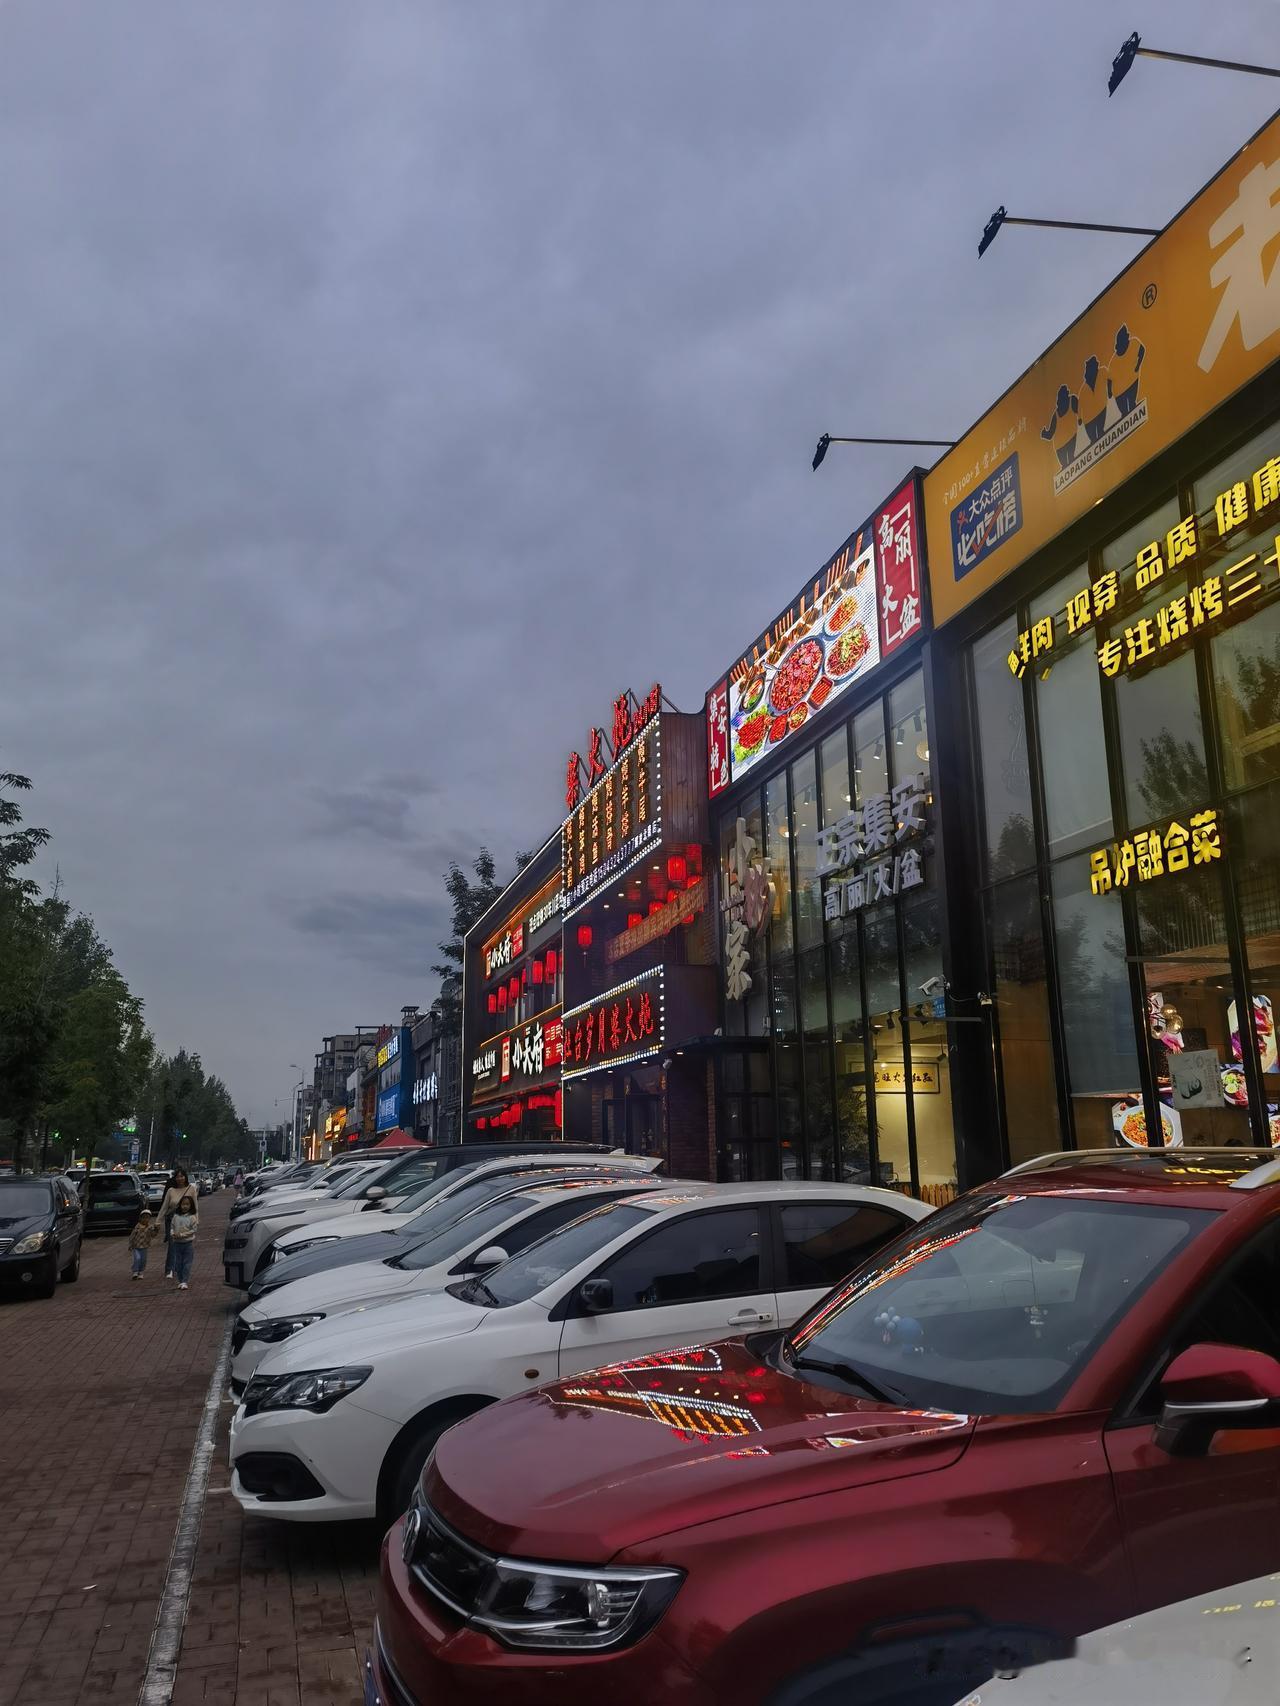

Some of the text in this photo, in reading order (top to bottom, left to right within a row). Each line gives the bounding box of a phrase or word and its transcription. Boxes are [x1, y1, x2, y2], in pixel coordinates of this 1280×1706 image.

[1055, 405, 1146, 490] LAOPANG CHUANDIAN
[957, 489, 1017, 567] 必吃榜
[968, 464, 1013, 523] 大众点评
[878, 514, 921, 639] 高丽火盆
[1065, 570, 1120, 635] 现穿
[1135, 514, 1198, 591] 品质
[1214, 456, 1280, 537] 健康
[709, 693, 729, 787] 集安特色
[823, 848, 925, 922] 高丽火盆
[1090, 808, 1222, 895] 吊炉融合菜
